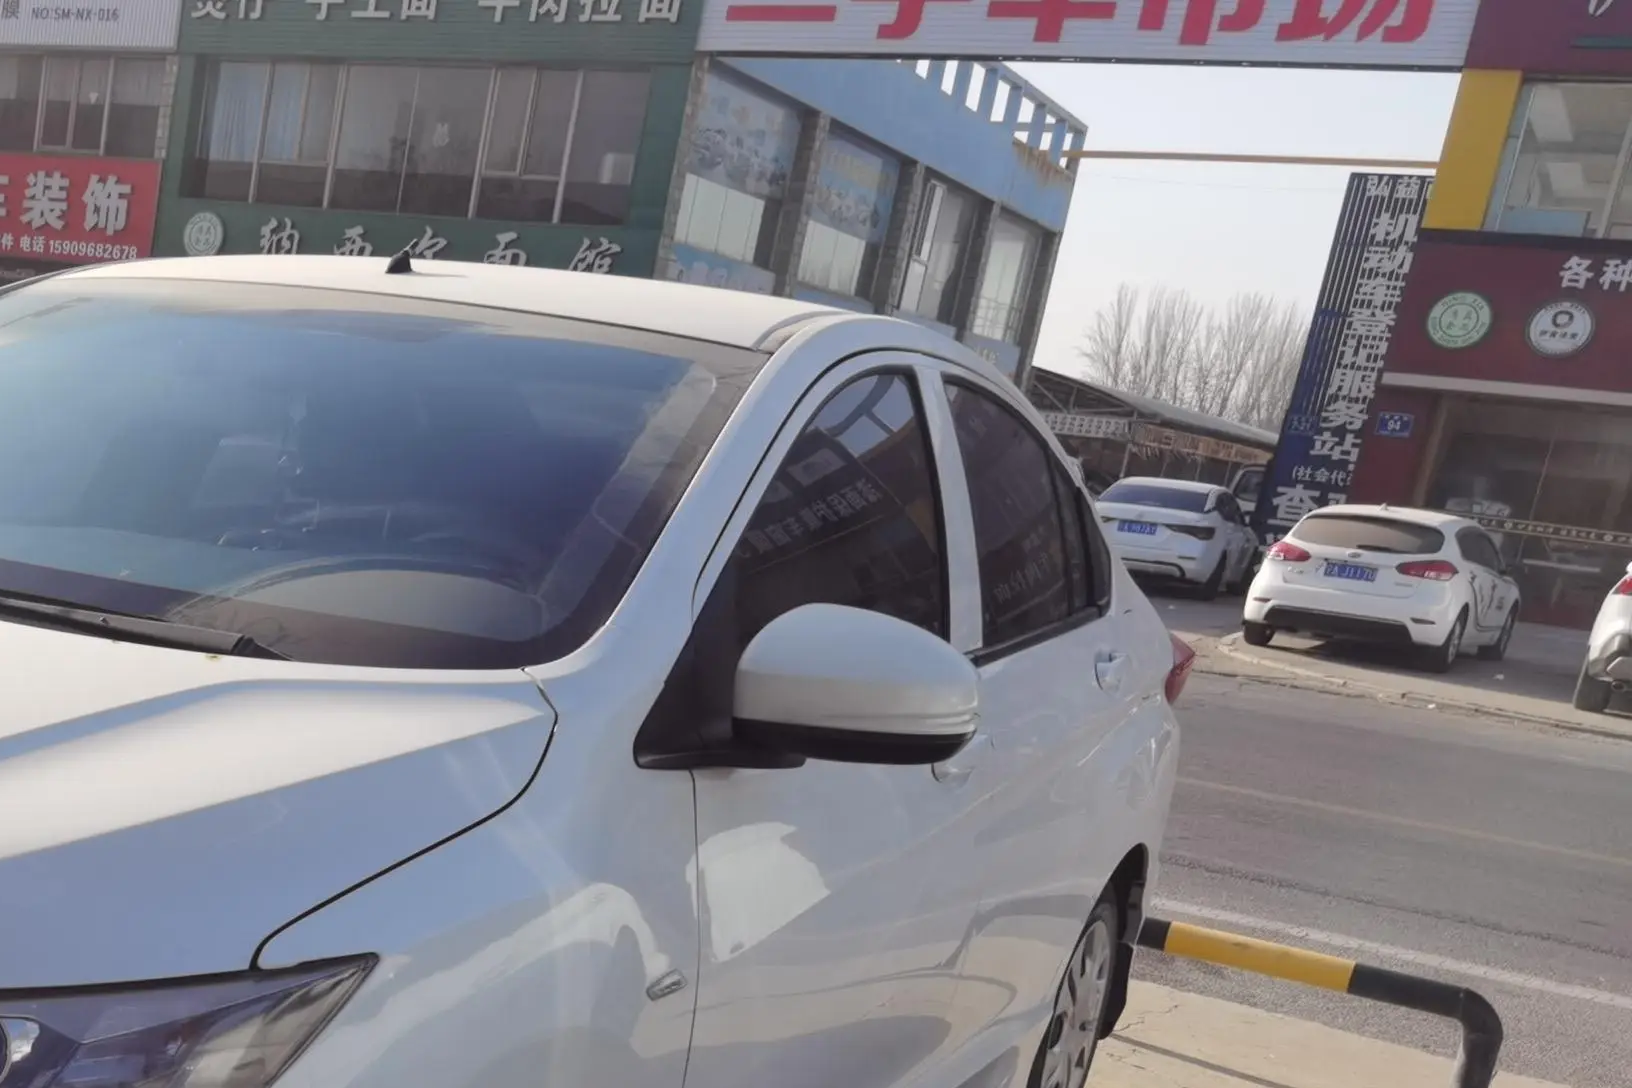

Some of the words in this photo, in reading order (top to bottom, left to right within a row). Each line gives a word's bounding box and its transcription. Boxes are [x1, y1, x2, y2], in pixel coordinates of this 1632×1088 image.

[20, 236, 46, 253] 电话
[49, 239, 138, 260] 15909682678
[1310, 212, 1420, 462] 机动车登记服务站
